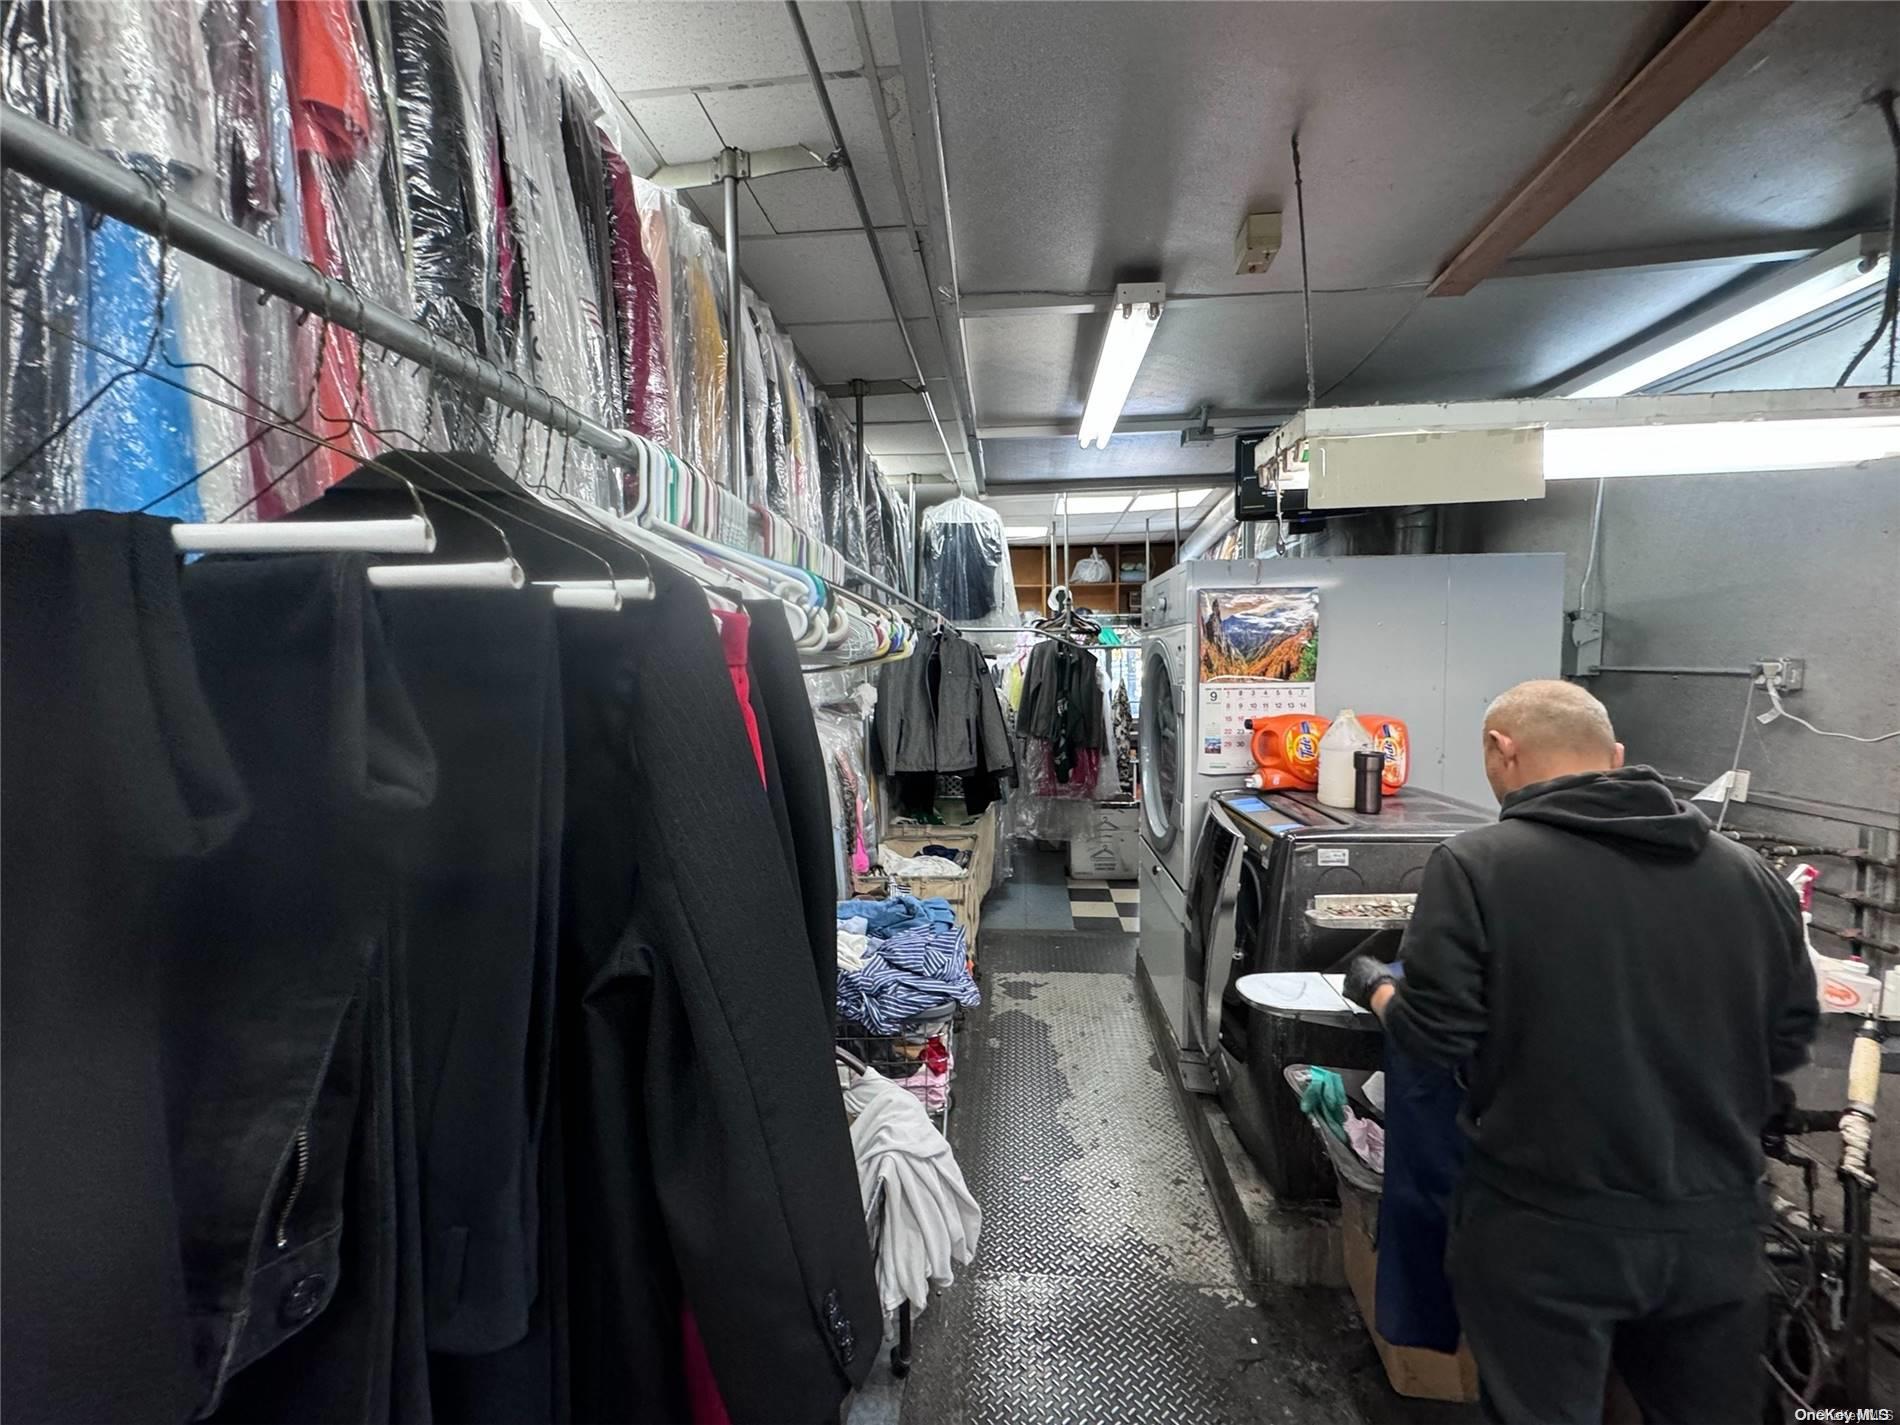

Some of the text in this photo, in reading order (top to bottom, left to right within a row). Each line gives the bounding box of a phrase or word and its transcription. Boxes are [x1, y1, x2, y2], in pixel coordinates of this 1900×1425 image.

[1210, 691, 1218, 701] 9
[1299, 737, 1315, 758] Tide
[1384, 741, 1394, 761] Tide
